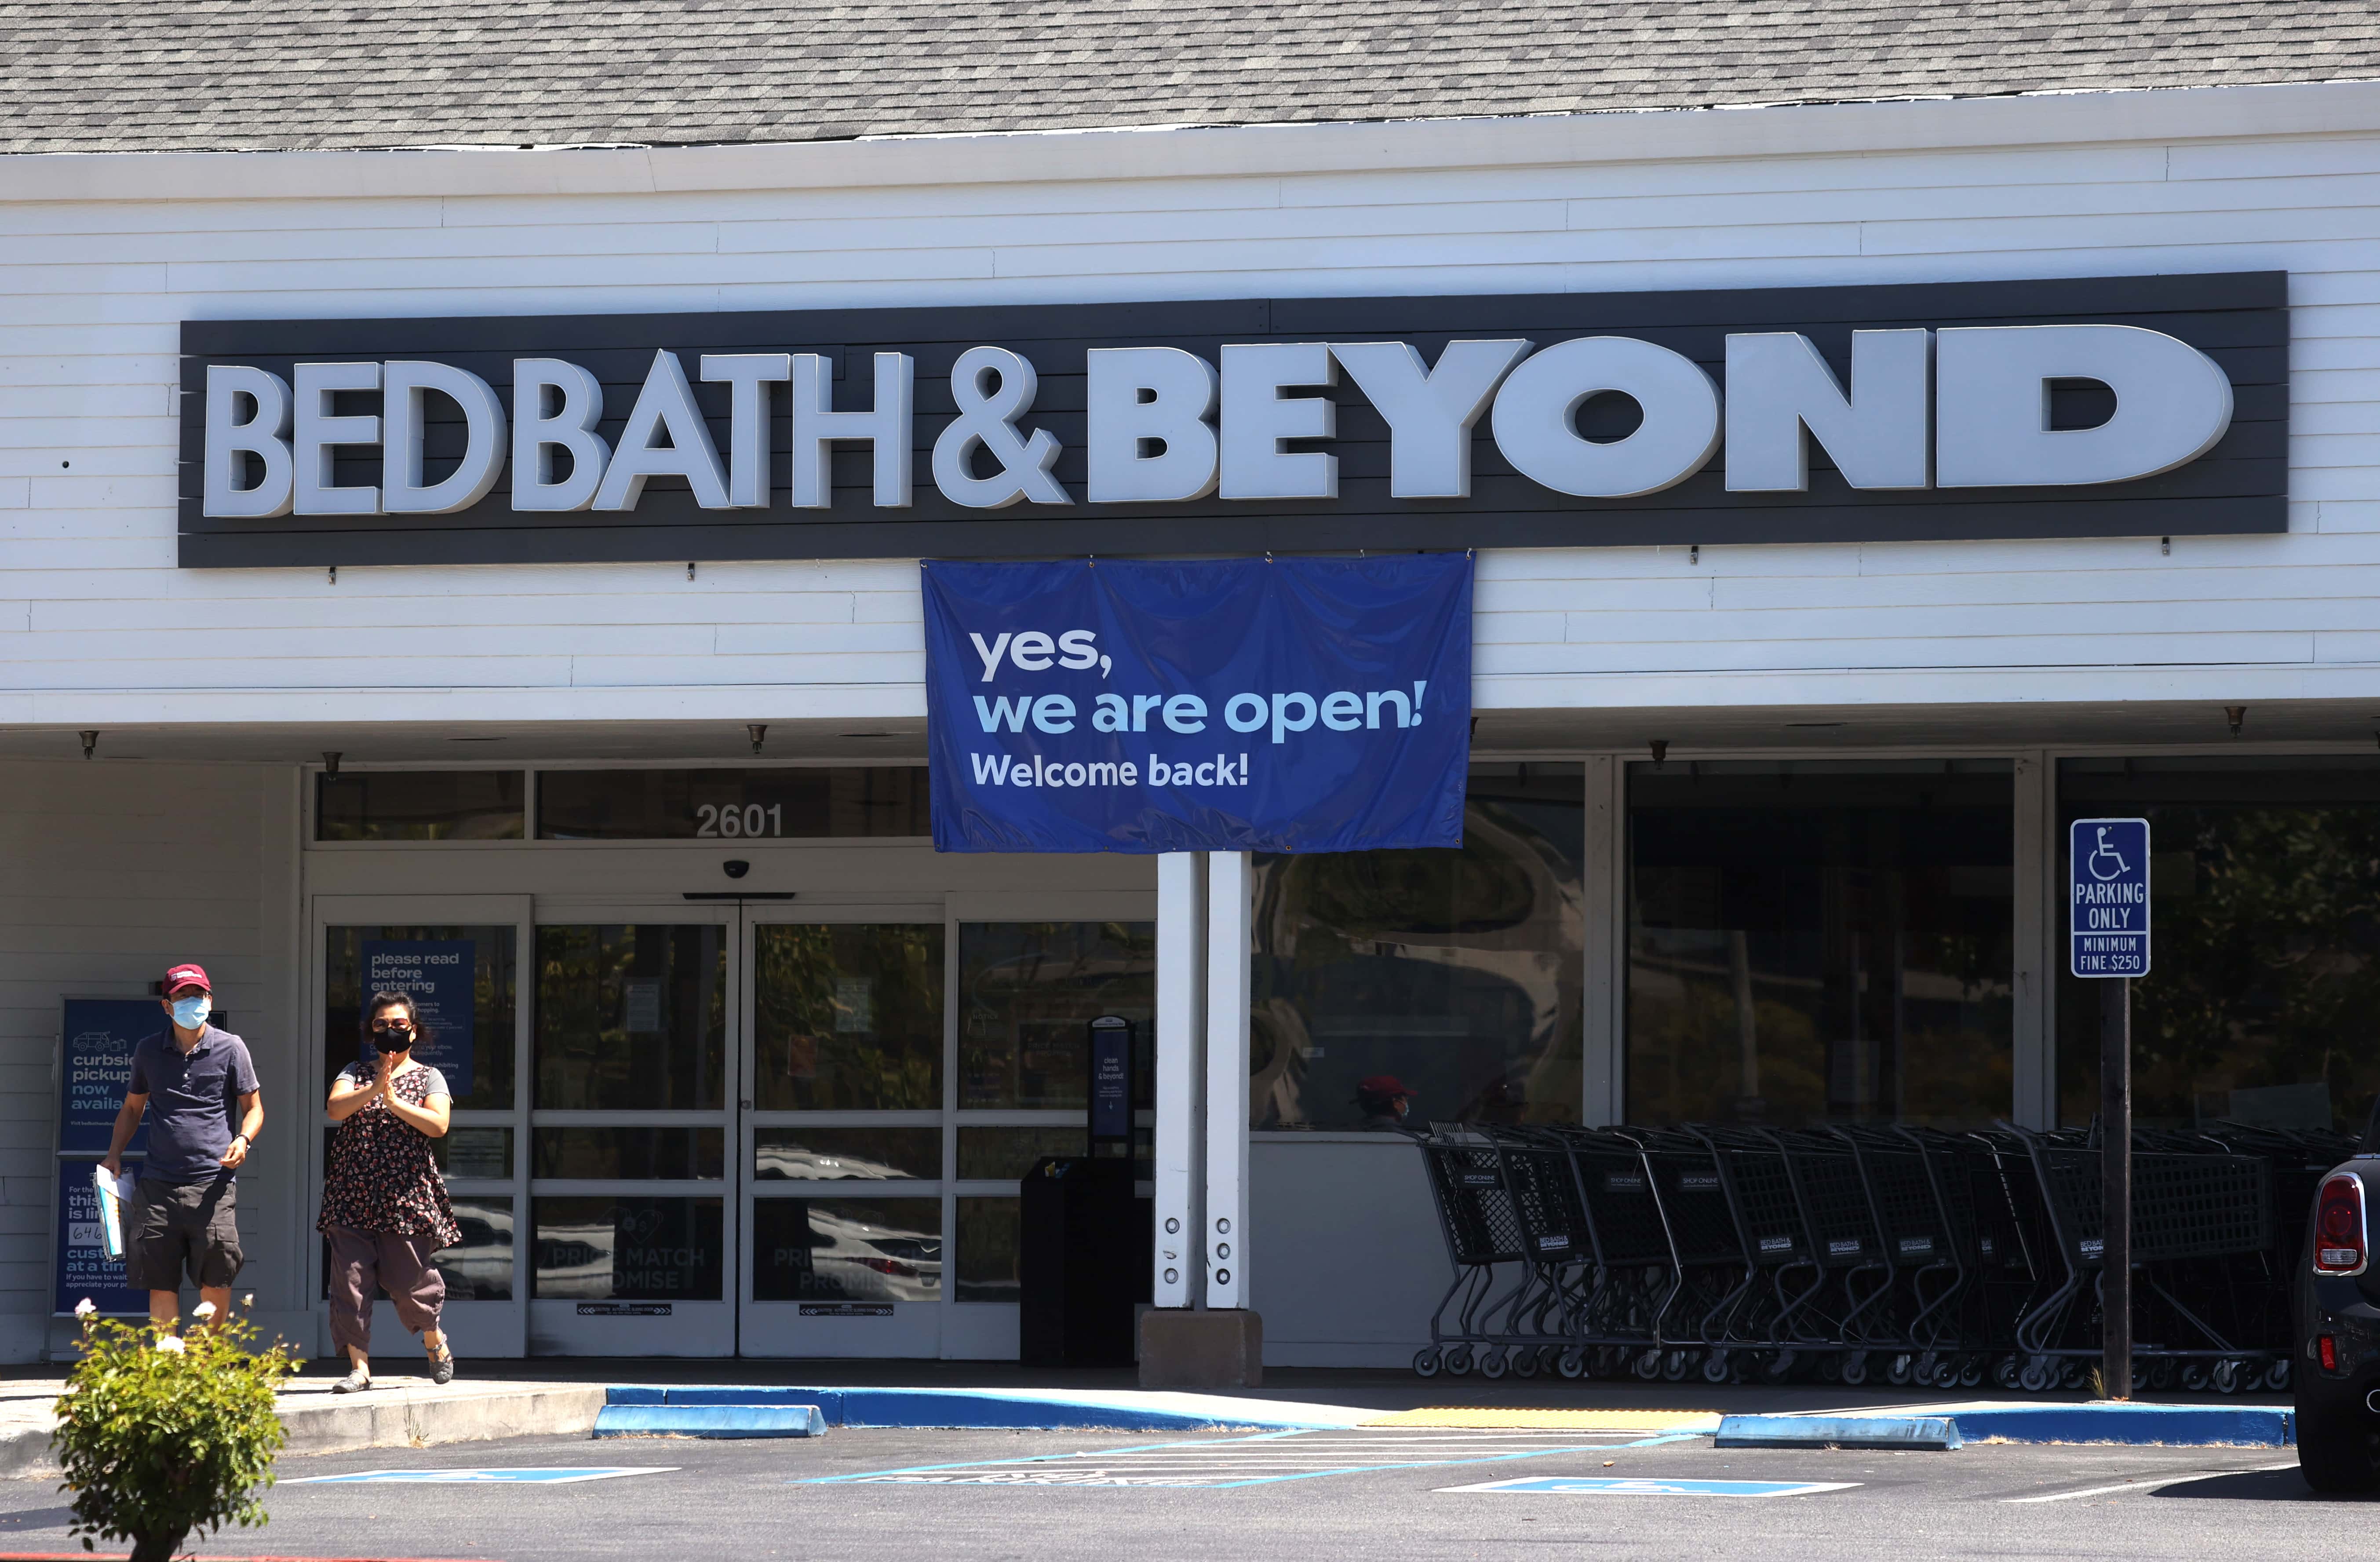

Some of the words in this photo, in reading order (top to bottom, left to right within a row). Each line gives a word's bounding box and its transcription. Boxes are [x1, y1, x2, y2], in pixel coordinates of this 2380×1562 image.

[203, 360, 507, 519] BED
[512, 347, 913, 512] BATH
[932, 346, 1075, 508] &
[1087, 324, 2234, 502] BEYOND
[969, 630, 1112, 682] yes,
[972, 693, 1076, 734] we
[1092, 693, 1208, 734] are
[1224, 680, 1427, 744] open!
[970, 753, 1138, 787] Welcome
[1148, 753, 1248, 786] back!
[696, 803, 782, 838] 2601
[2076, 883, 2144, 904] PARKING
[2088, 908, 2131, 929] ONLY
[2084, 937, 2136, 952] MINIMUM
[371, 953, 421, 966] please
[424, 953, 459, 964] read
[2081, 956, 2107, 970] FINE
[2111, 955, 2140, 971] $250
[371, 967, 422, 978] before
[371, 980, 435, 993] entering
[72, 1068, 131, 1083] pickup
[72, 1084, 109, 1095] now
[69, 1208, 83, 1219] is
[626, 1248, 705, 1266] MATCH
[66, 1262, 84, 1272] at
[87, 1263, 98, 1272] a
